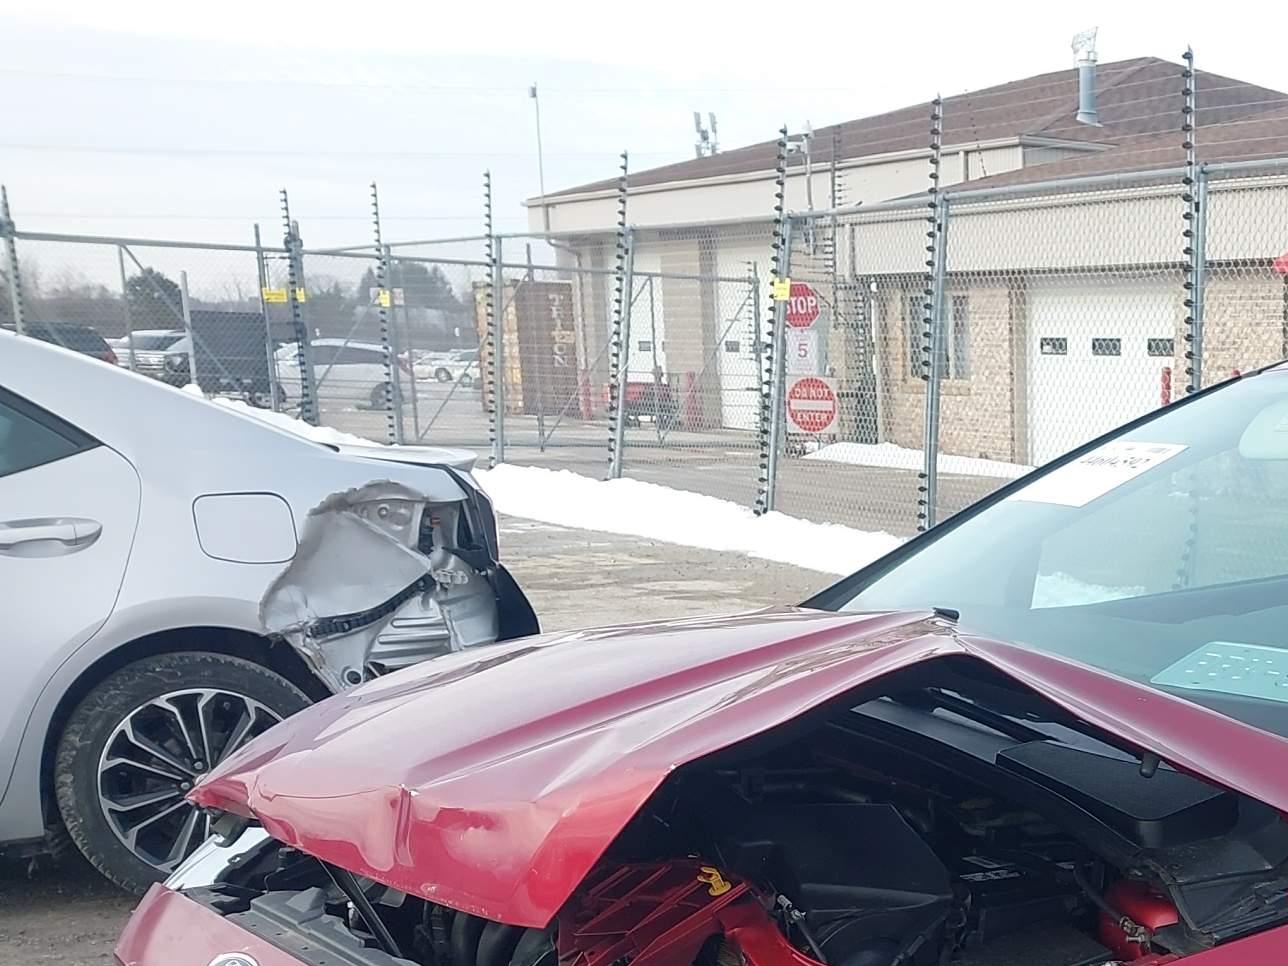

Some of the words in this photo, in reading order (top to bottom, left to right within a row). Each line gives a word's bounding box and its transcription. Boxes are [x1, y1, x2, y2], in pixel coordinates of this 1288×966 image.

[797, 342, 809, 359] 5
[809, 388, 830, 399] NOT
[796, 412, 830, 422] ENTER
